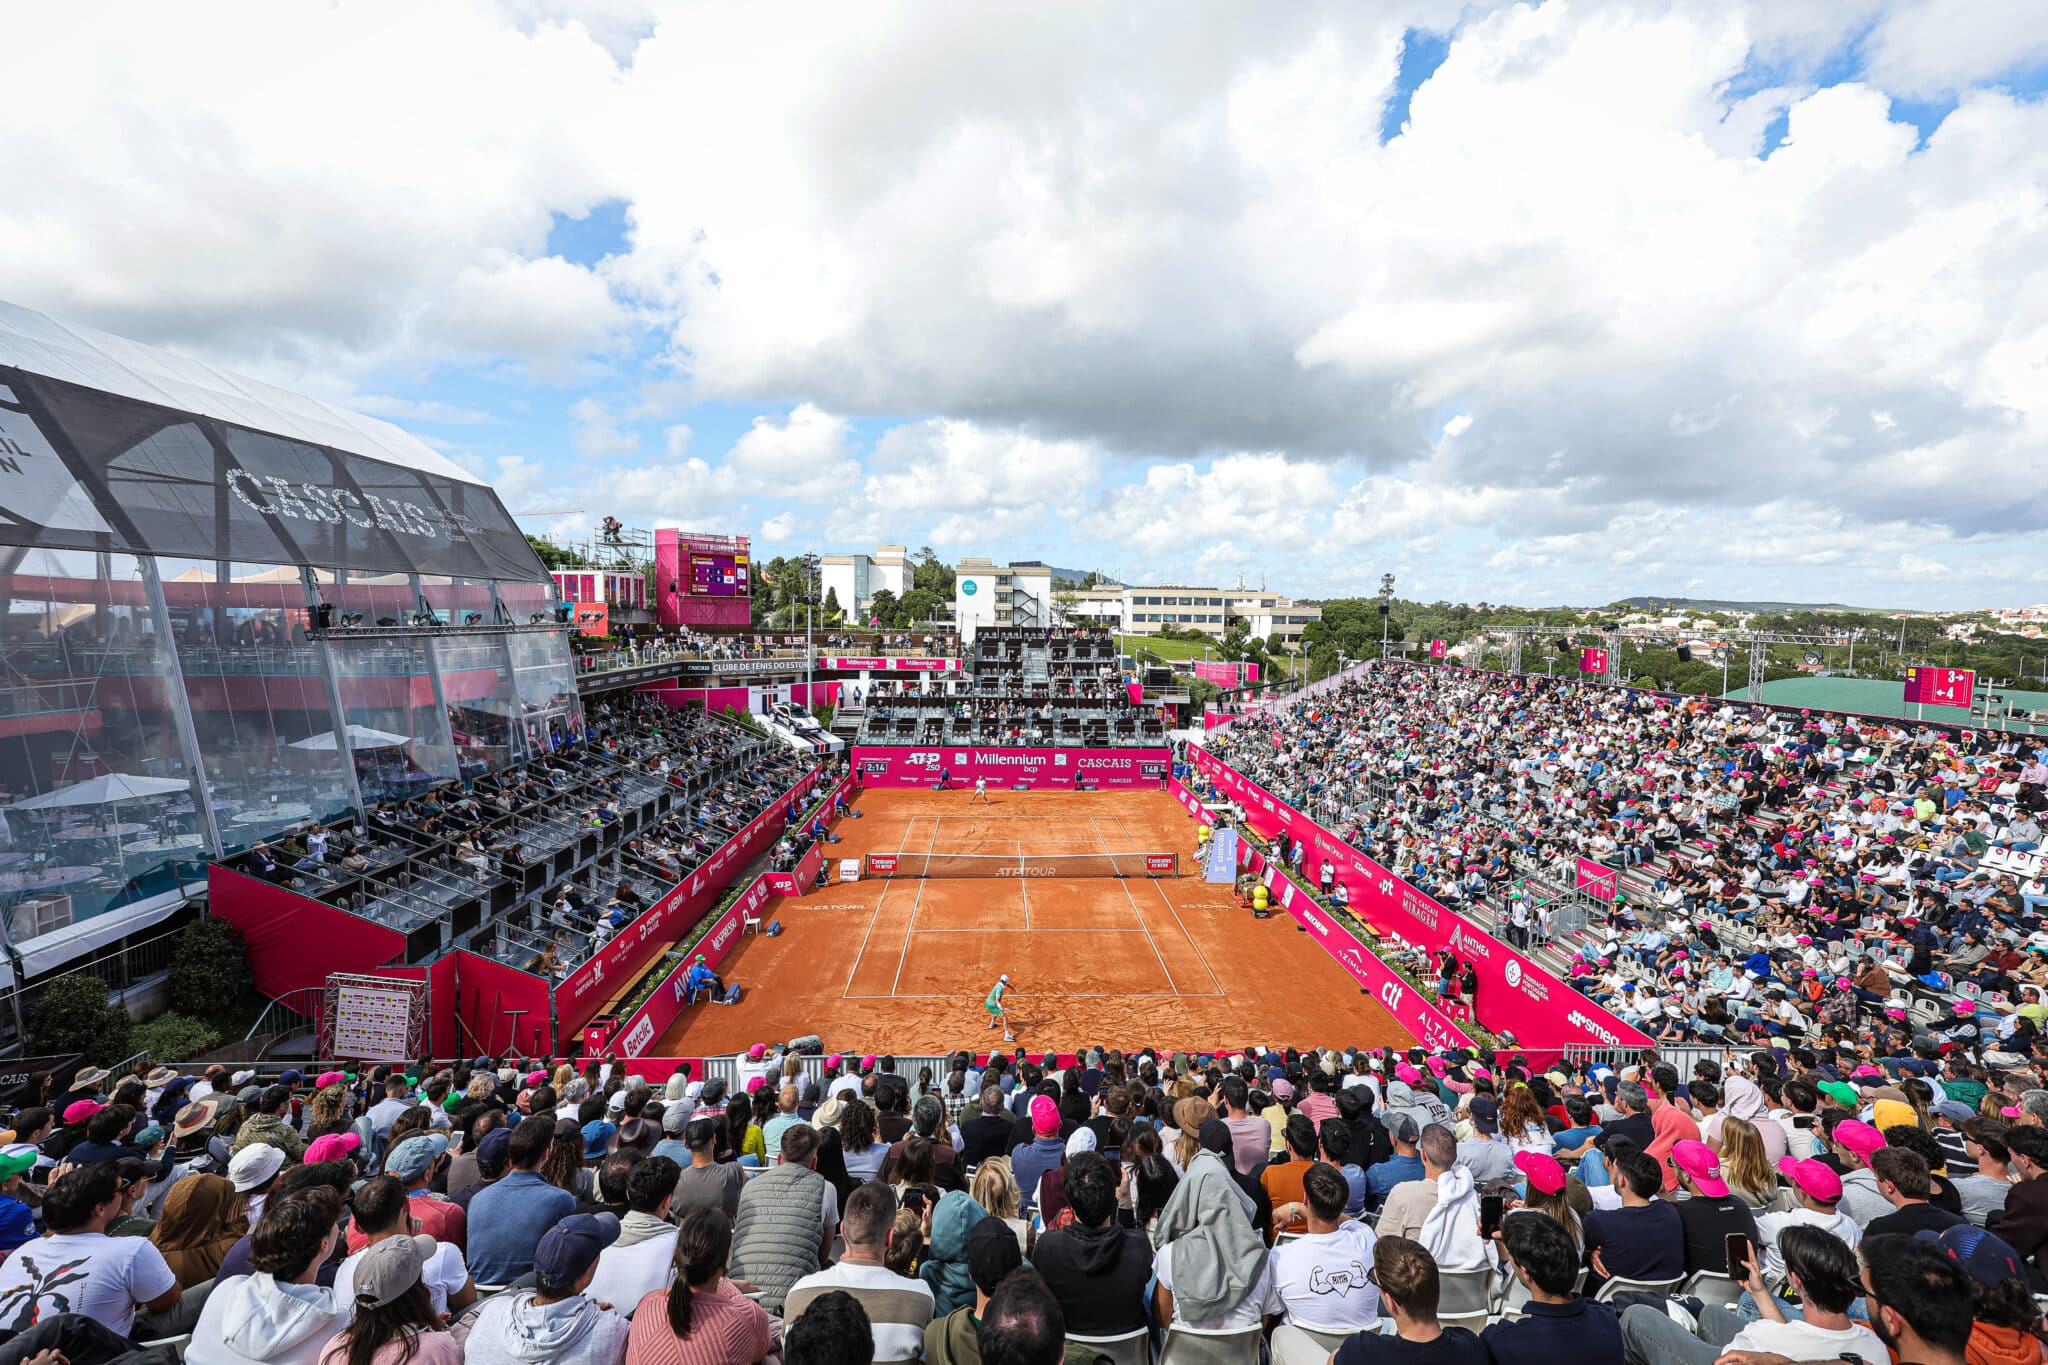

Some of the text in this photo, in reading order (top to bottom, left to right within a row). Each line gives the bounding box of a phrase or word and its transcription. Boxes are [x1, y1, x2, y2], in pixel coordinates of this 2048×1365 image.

[226, 468, 436, 537] CASCAIS
[1948, 670, 1955, 683] 3
[1946, 687, 1954, 699] 4
[905, 752, 940, 764] ATP
[975, 751, 1046, 765] Millennium
[1078, 758, 1132, 768] CASCAIS
[1024, 765, 1038, 773] bcp
[996, 868, 1056, 876] ATP TOUR
[774, 880, 792, 889] ATP
[1403, 890, 1438, 917] HOTEL CASCAIS
[1402, 899, 1437, 930] MIRAGEM
[710, 918, 738, 952] NESPRESSO
[1464, 934, 1490, 958] ANTHEA
[1382, 981, 1403, 1011] ctt
[590, 1031, 598, 1039] 4
[627, 1022, 651, 1056] Betclic
[1584, 1018, 1620, 1050] smeg
